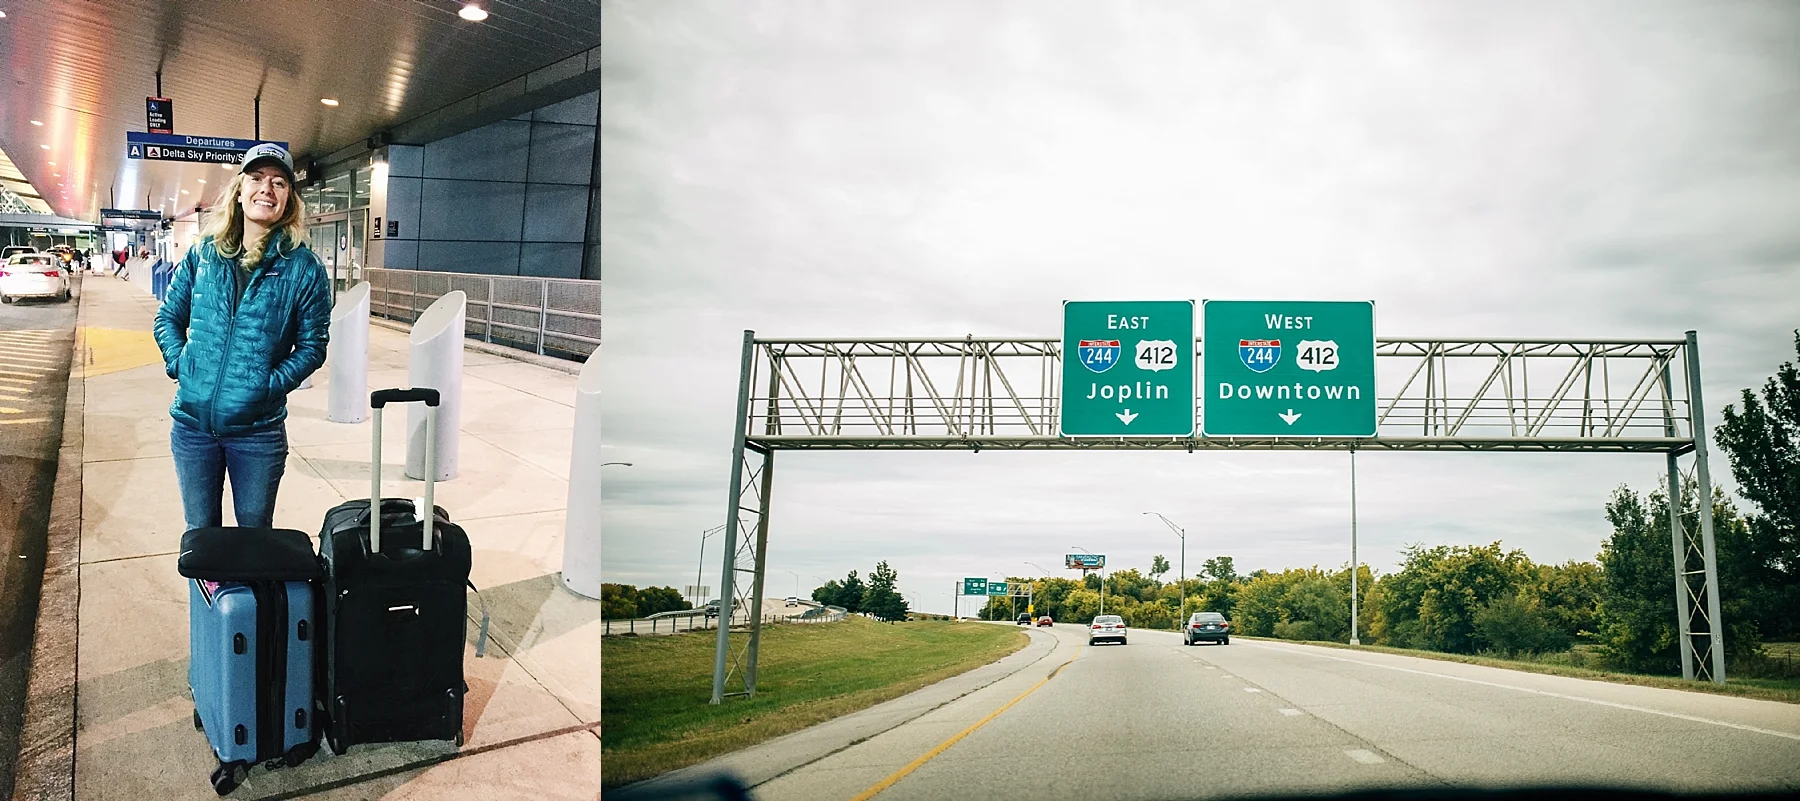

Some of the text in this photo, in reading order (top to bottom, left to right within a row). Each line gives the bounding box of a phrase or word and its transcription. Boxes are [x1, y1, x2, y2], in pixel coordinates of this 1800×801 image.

[149, 117, 167, 125] Loading
[186, 136, 235, 148] Departures
[130, 145, 140, 156] A
[162, 148, 186, 158] Delta
[187, 150, 204, 161] Sky
[205, 151, 246, 163] Priority/S
[1107, 314, 1150, 330] EAST
[1264, 313, 1313, 330] WEST
[1086, 348, 1112, 364] 244
[1139, 346, 1173, 364] 412
[1247, 347, 1273, 364] 244
[1300, 347, 1335, 365] 412
[1086, 381, 1169, 403] Joplin
[1219, 382, 1360, 400] Downtown
